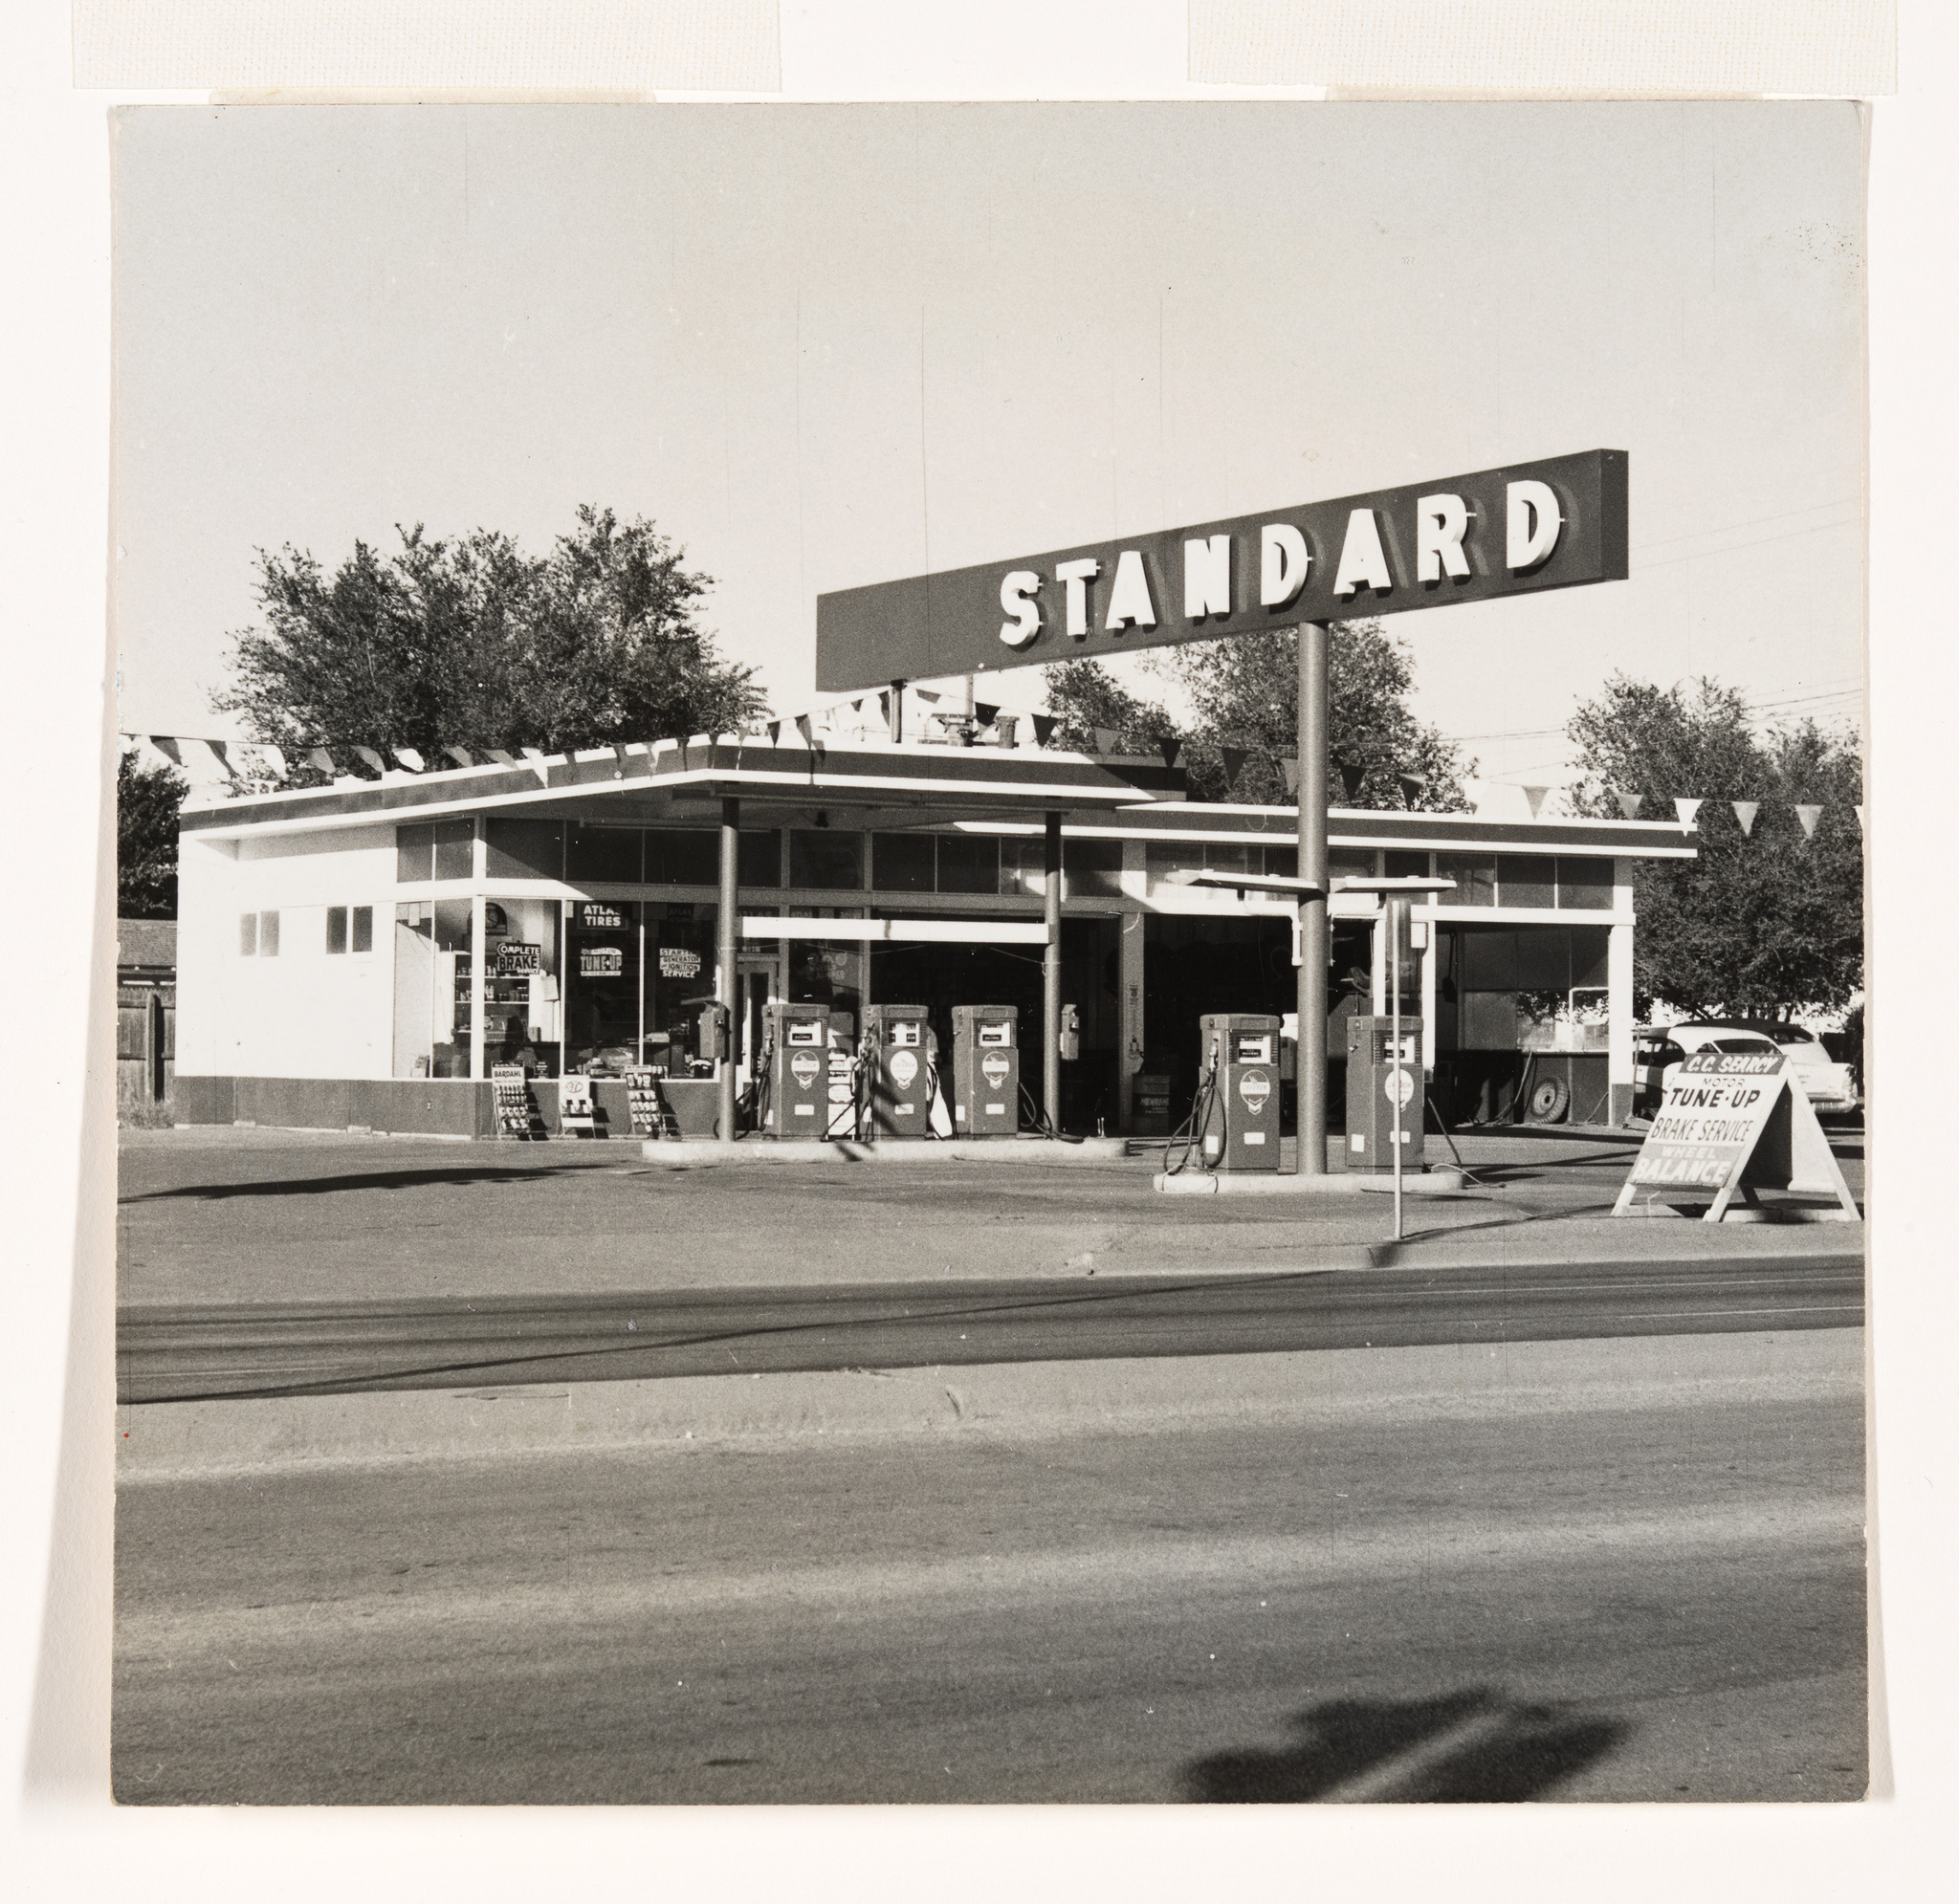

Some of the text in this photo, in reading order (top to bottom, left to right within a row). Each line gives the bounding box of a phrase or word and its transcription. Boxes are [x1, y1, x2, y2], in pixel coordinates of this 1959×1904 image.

[1000, 479, 1560, 647] STANDARD
[584, 915, 622, 927] TIRES
[496, 942, 540, 956] COMPLETE
[498, 955, 538, 971] BRAKE
[662, 970, 695, 978] SERVICE
[1718, 1055, 1779, 1073] SEARCY
[1703, 1078, 1747, 1088] MOTOR
[1650, 1117, 1754, 1142] BRAKE SERVICE
[1662, 1146, 1717, 1159] WHEEL
[1632, 1158, 1731, 1182] BALANCE
